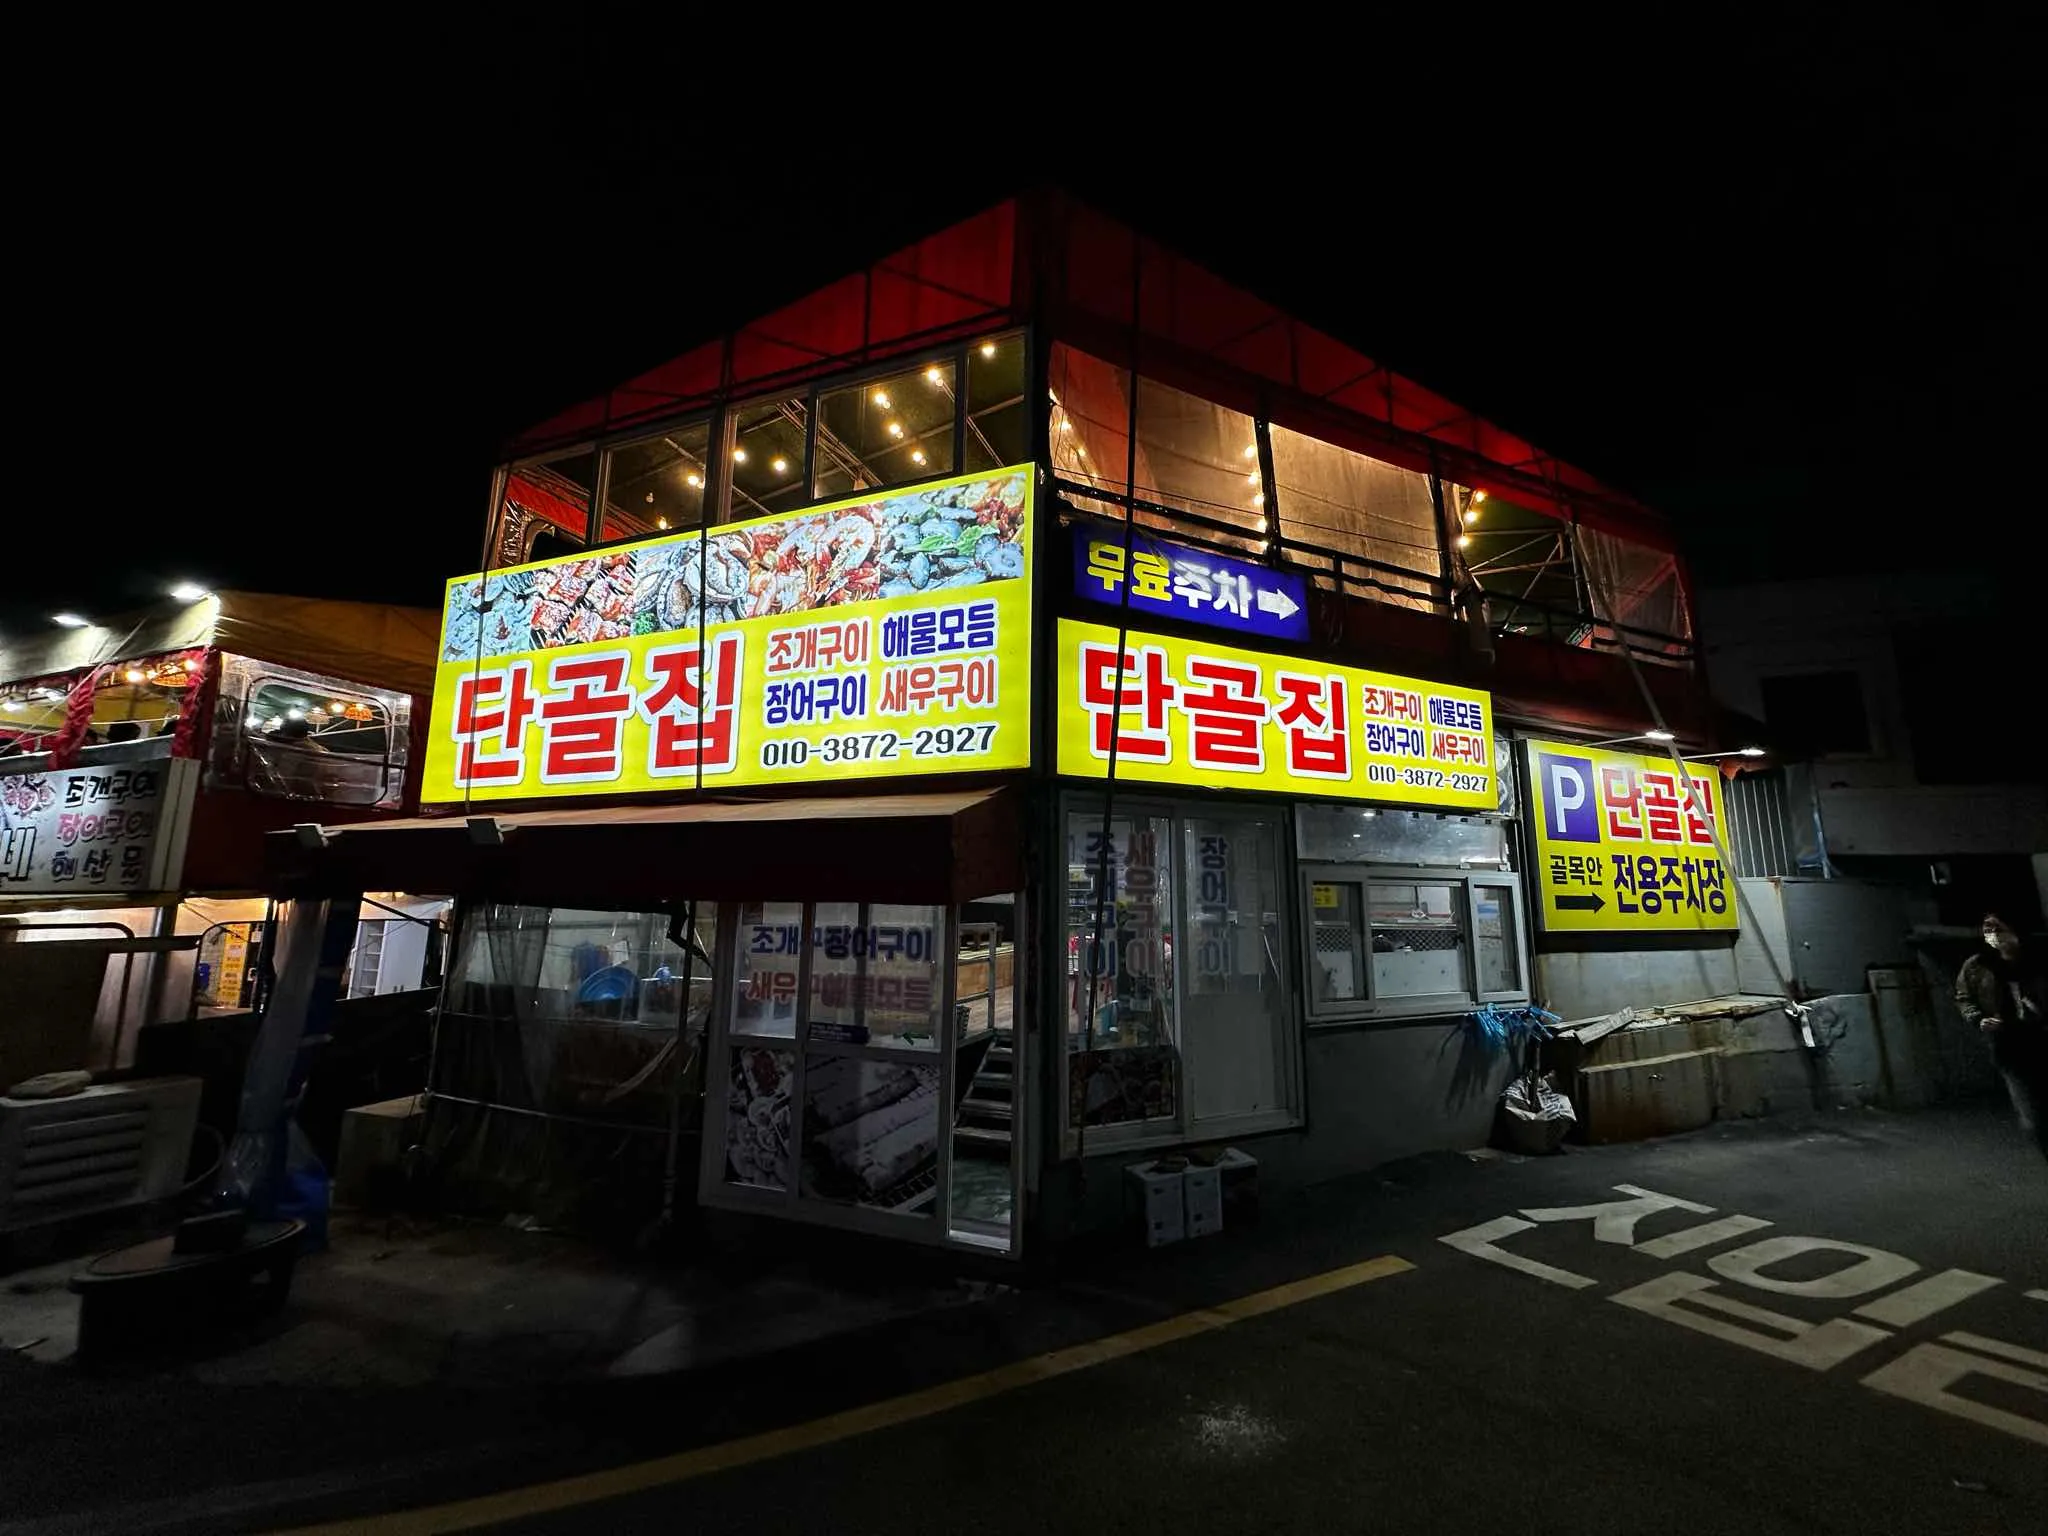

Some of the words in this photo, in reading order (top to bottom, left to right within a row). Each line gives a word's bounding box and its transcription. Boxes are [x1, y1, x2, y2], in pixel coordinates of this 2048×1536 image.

[1087, 540, 1253, 620] 무료주차
[768, 618, 870, 672] 조개구이
[883, 602, 997, 658] 해물모듬
[455, 638, 739, 781] 단골집
[766, 675, 868, 724] 장어구이
[880, 657, 998, 713] 새우구이
[1083, 646, 1348, 775] 단골집
[1364, 686, 1422, 722] 조개구이
[1428, 698, 1483, 732] 해물모듬
[762, 725, 997, 767] 010-3872-2927
[1366, 724, 1425, 757] 장어구이
[1431, 737, 1486, 765] 새우구이
[1368, 764, 1488, 792] 010-3872-2927
[57, 810, 152, 846] 장어구이
[1551, 764, 1585, 833] P
[1602, 767, 1715, 844] 단골집
[1126, 831, 1156, 978] 새우구이
[1550, 854, 1603, 887] 골목안
[1611, 854, 1728, 914] 전용주차장
